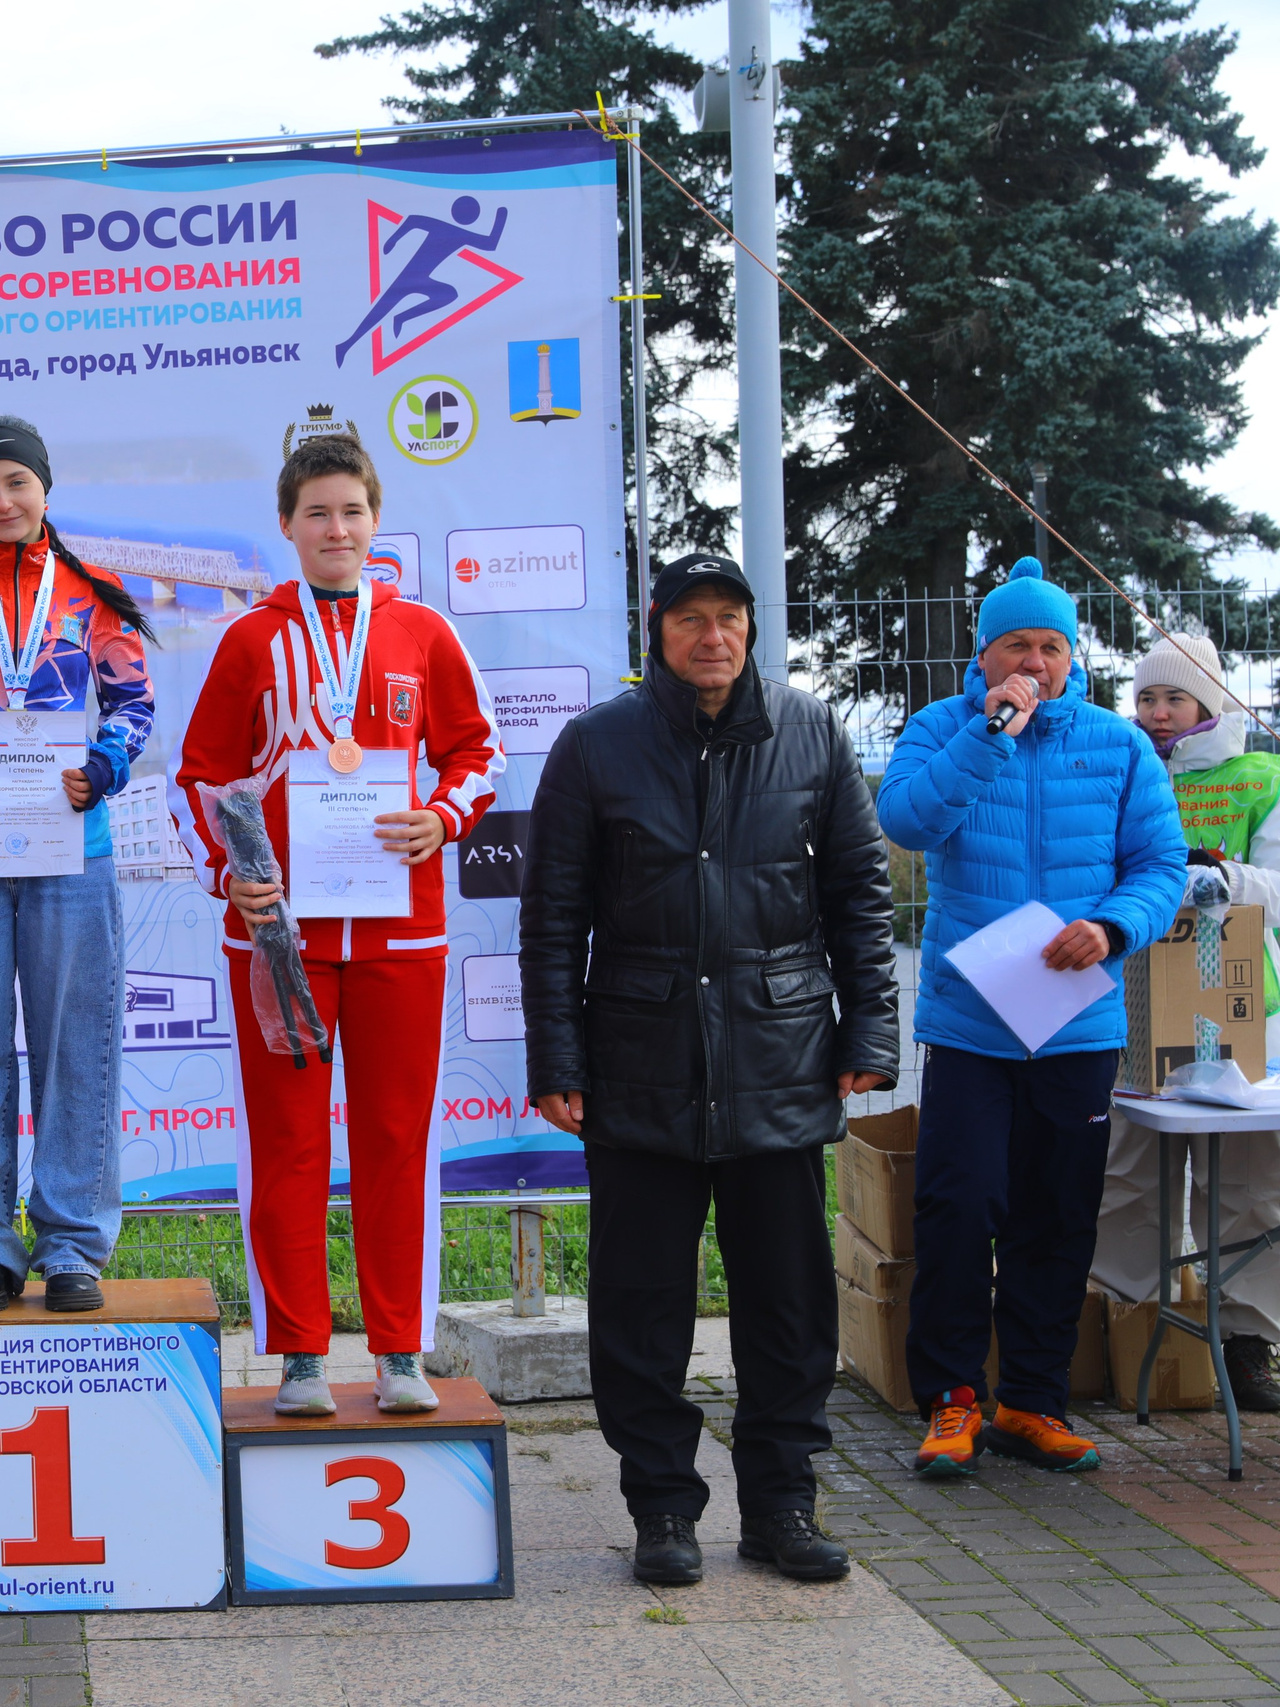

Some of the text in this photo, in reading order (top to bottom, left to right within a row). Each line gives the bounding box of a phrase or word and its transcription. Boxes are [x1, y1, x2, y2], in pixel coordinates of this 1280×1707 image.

[61, 200, 297, 254] РОССИИ
[45, 297, 302, 332] ОРИЕНТИРОВАНИЯ
[47, 352, 136, 380] город
[142, 343, 301, 370] Ульяновск
[300, 423, 343, 432] ТРИУМФ
[488, 551, 578, 574] azimut
[24, 625, 40, 668] МИНИСТЕРСТВО
[36, 606, 44, 624] СПОРТА
[355, 611, 366, 650] МИНИСТЕРСТВО
[1, 643, 10, 668] РОССИИ
[348, 673, 356, 697] РОССИИ
[495, 694, 556, 704] МЕТАЛЛО
[495, 702, 586, 716] ПРОФИЛЬНЫЙ
[496, 718, 538, 727] ЗАВОД
[0, 754, 55, 764] ДИПЛОМ
[320, 793, 377, 803] ДИПЛОМ
[1173, 782, 1263, 797] ортивного
[442, 1097, 512, 1121] ХОМ
[39, 1335, 180, 1354] СПОРТИВНОГО
[87, 1378, 167, 1394] ОБЛАСТИ
[324, 1455, 411, 1569] 3
[0, 1577, 115, 1596] ul-orient.ru
